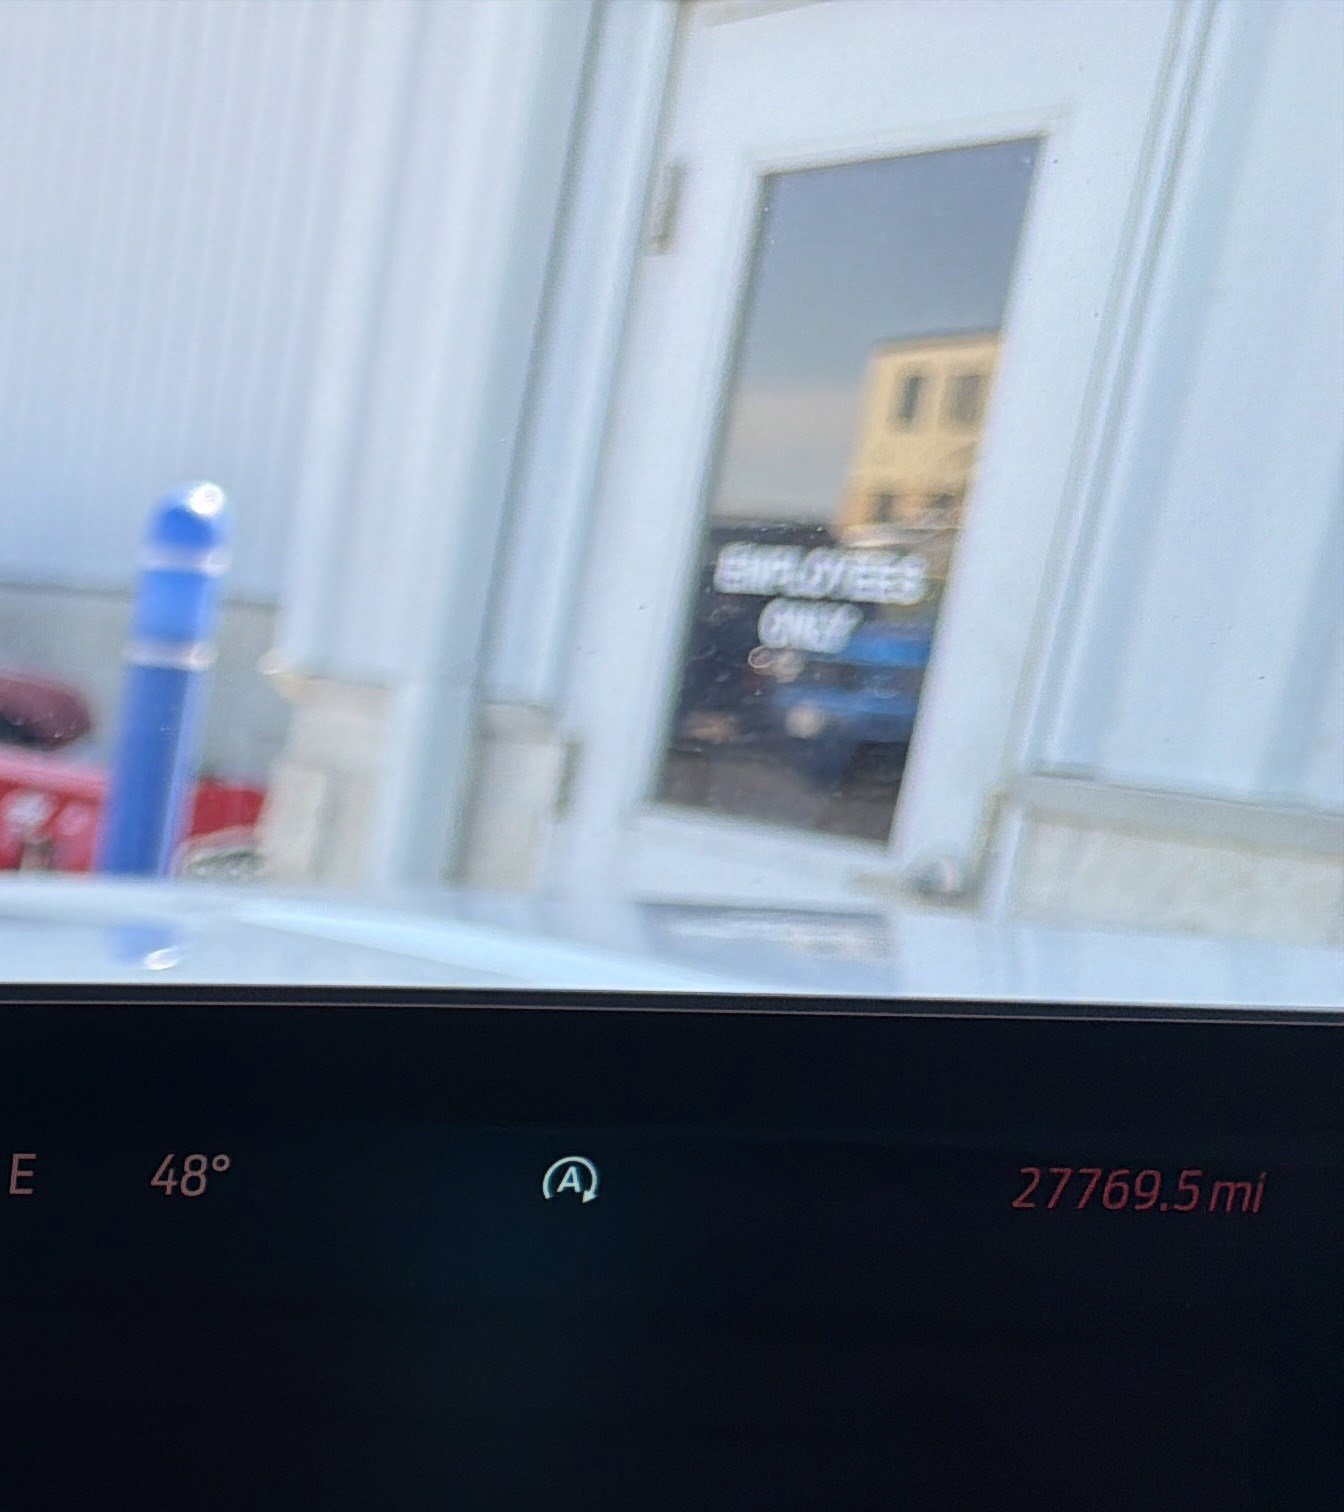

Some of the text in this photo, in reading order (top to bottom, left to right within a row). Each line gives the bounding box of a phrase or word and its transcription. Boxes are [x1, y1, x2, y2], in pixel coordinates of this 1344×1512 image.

[10, 1154, 35, 1194] E
[150, 1153, 232, 1197] 48°
[1012, 1167, 1266, 1213] 27769.5 mi
